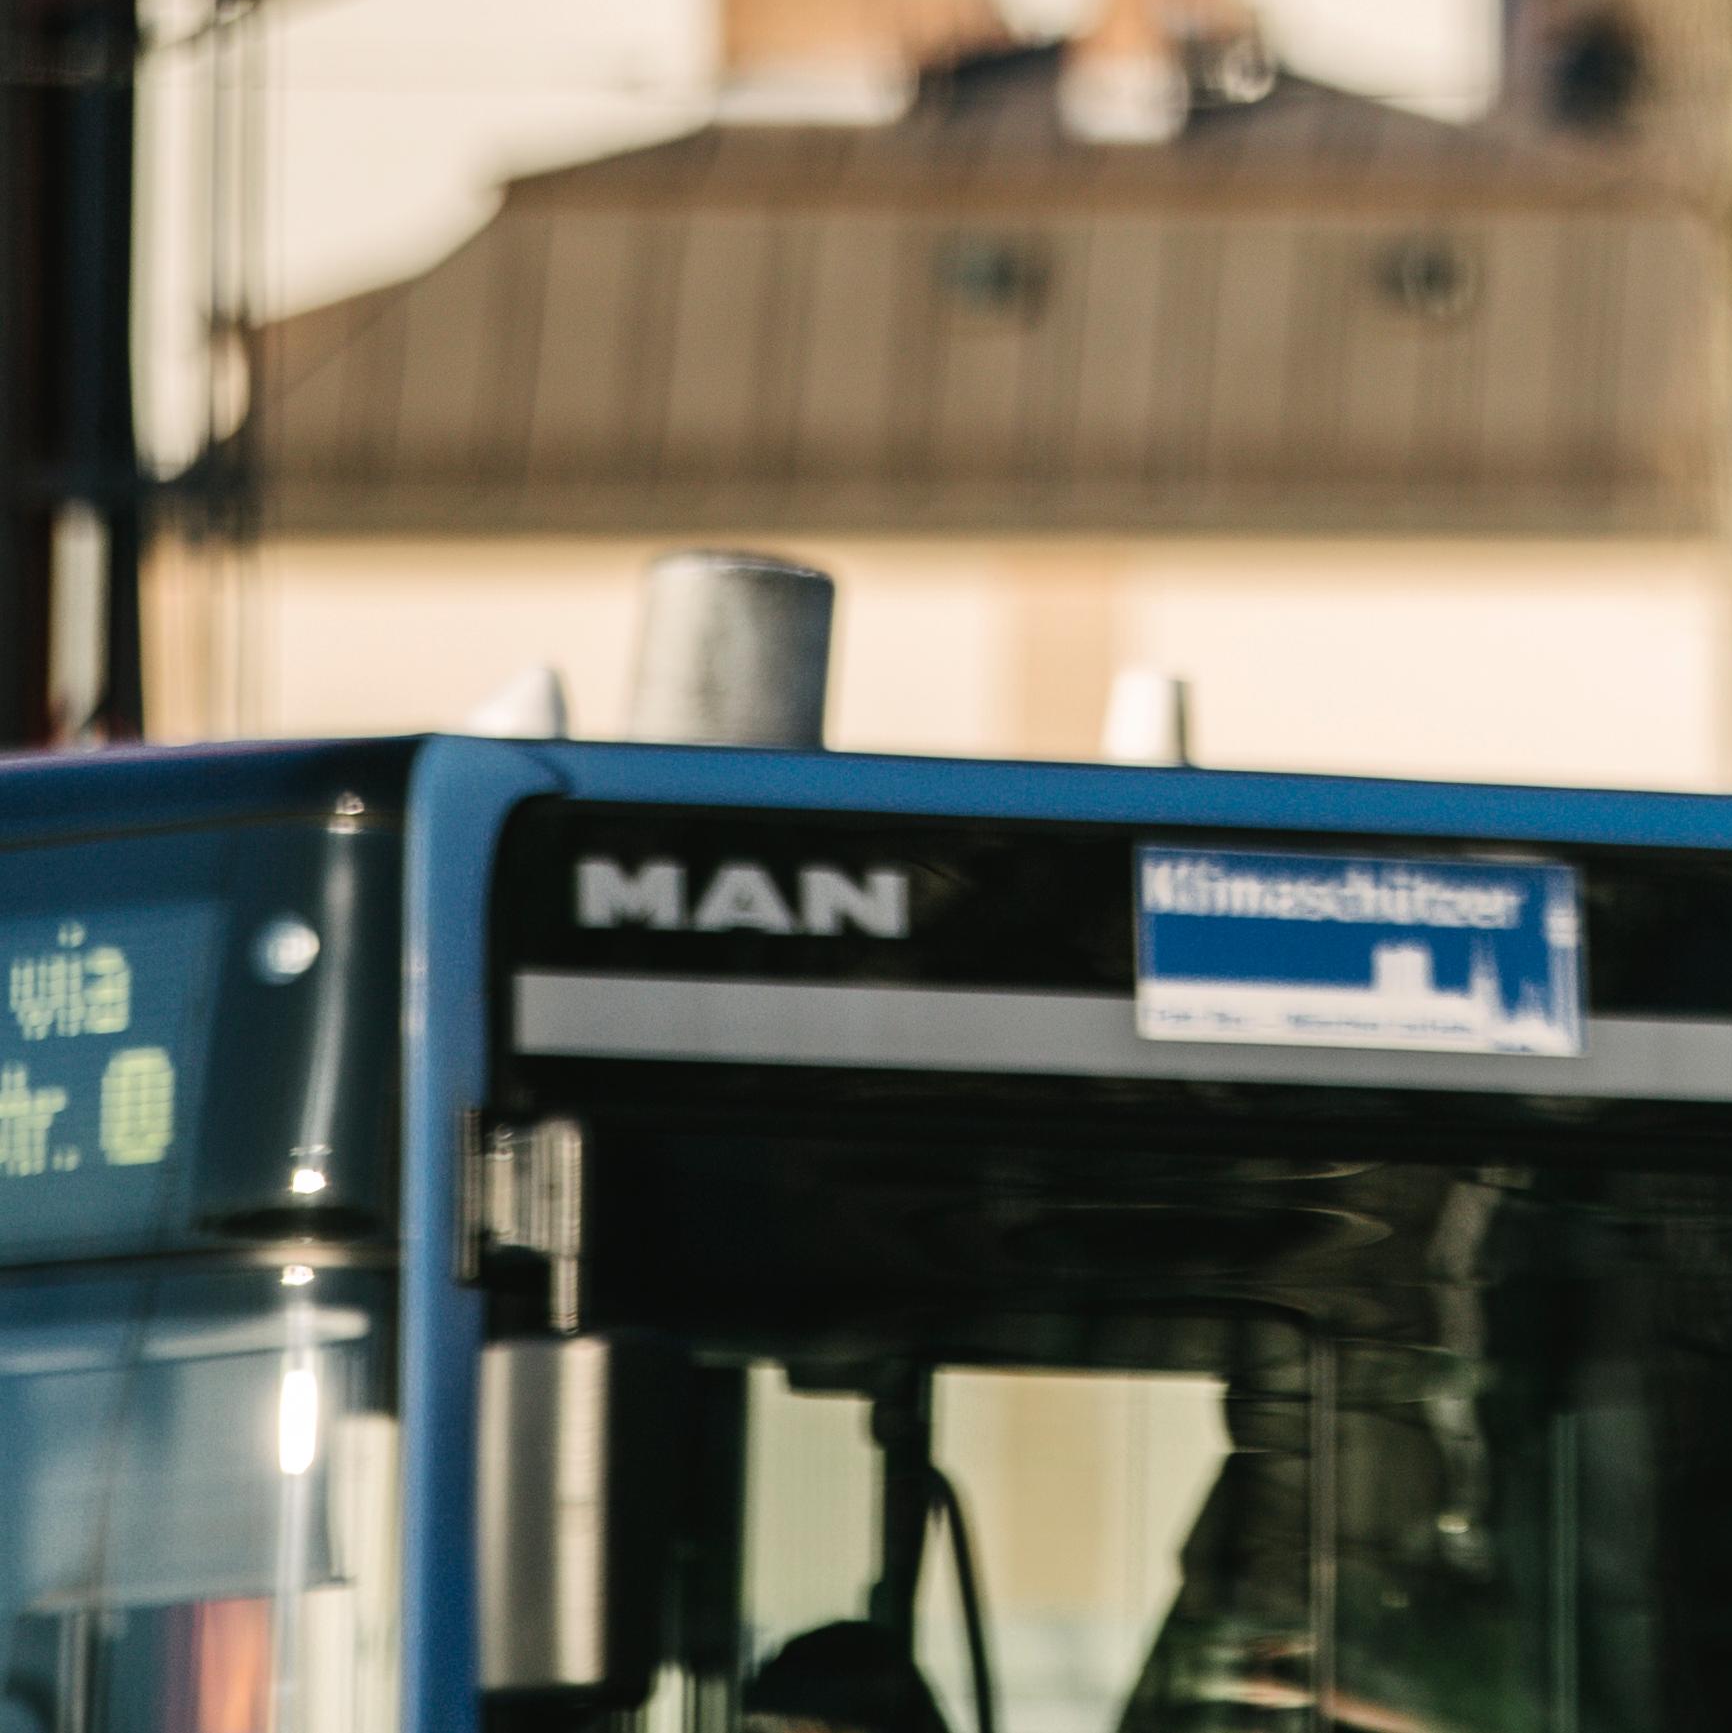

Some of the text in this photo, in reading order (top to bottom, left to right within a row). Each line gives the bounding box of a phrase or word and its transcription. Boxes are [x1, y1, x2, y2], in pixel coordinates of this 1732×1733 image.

[574, 859, 911, 938] MAN
[1141, 858, 1521, 929] Klimaschützer
[10, 921, 132, 1041] via
[0, 1060, 82, 1176] tr.
